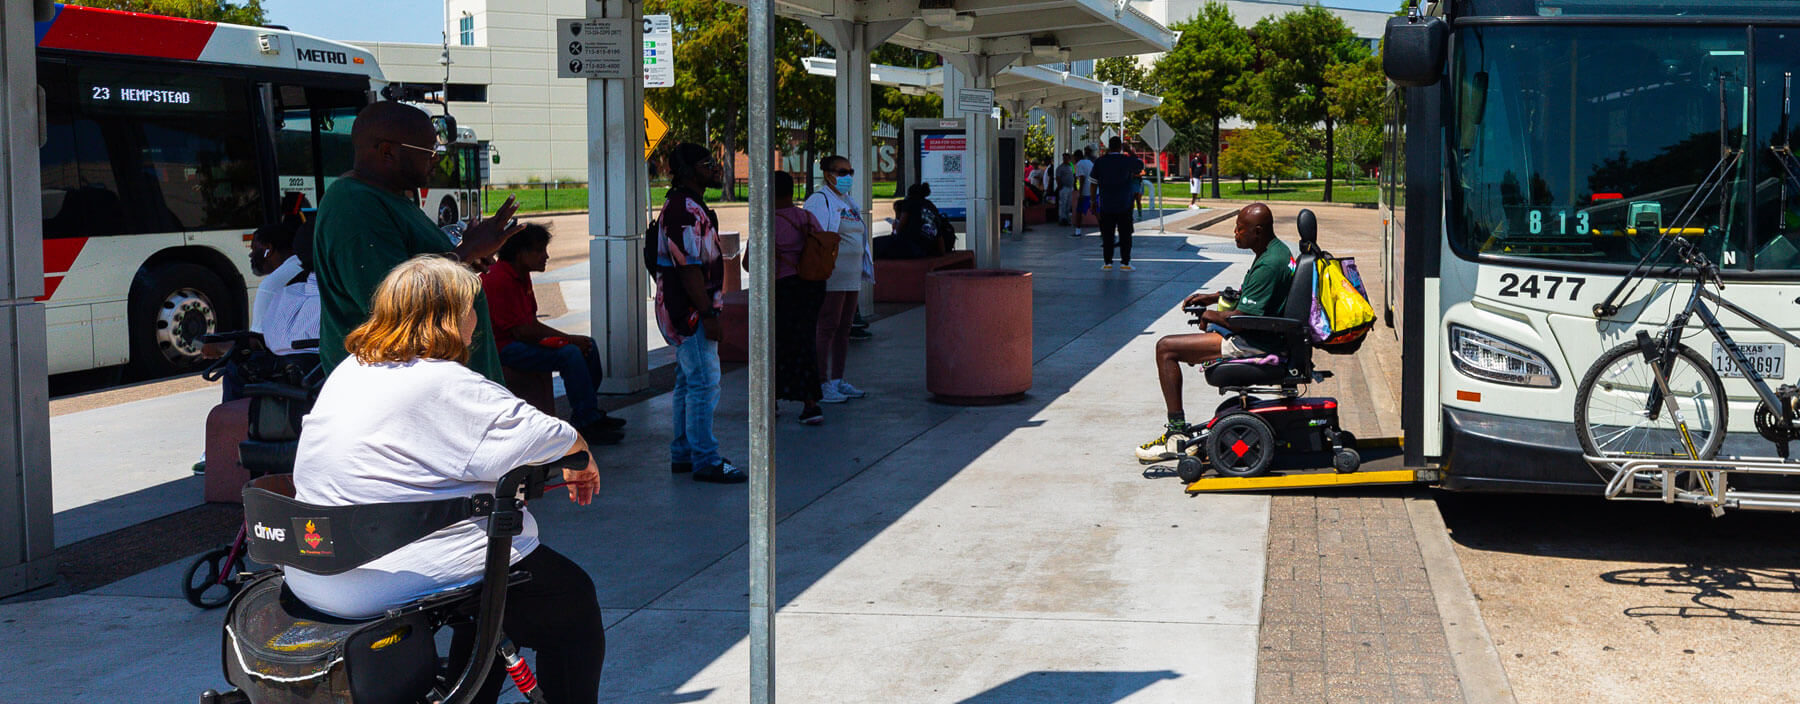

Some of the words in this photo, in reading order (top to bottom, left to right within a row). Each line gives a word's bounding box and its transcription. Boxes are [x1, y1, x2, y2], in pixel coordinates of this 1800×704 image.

[296, 48, 348, 65] METRO
[92, 86, 111, 100] 23
[120, 88, 191, 104] HEMPSTEAD
[1112, 87, 1119, 96] B
[1723, 250, 1736, 265] N
[1498, 272, 1587, 302] 2477
[254, 521, 285, 543] drive
